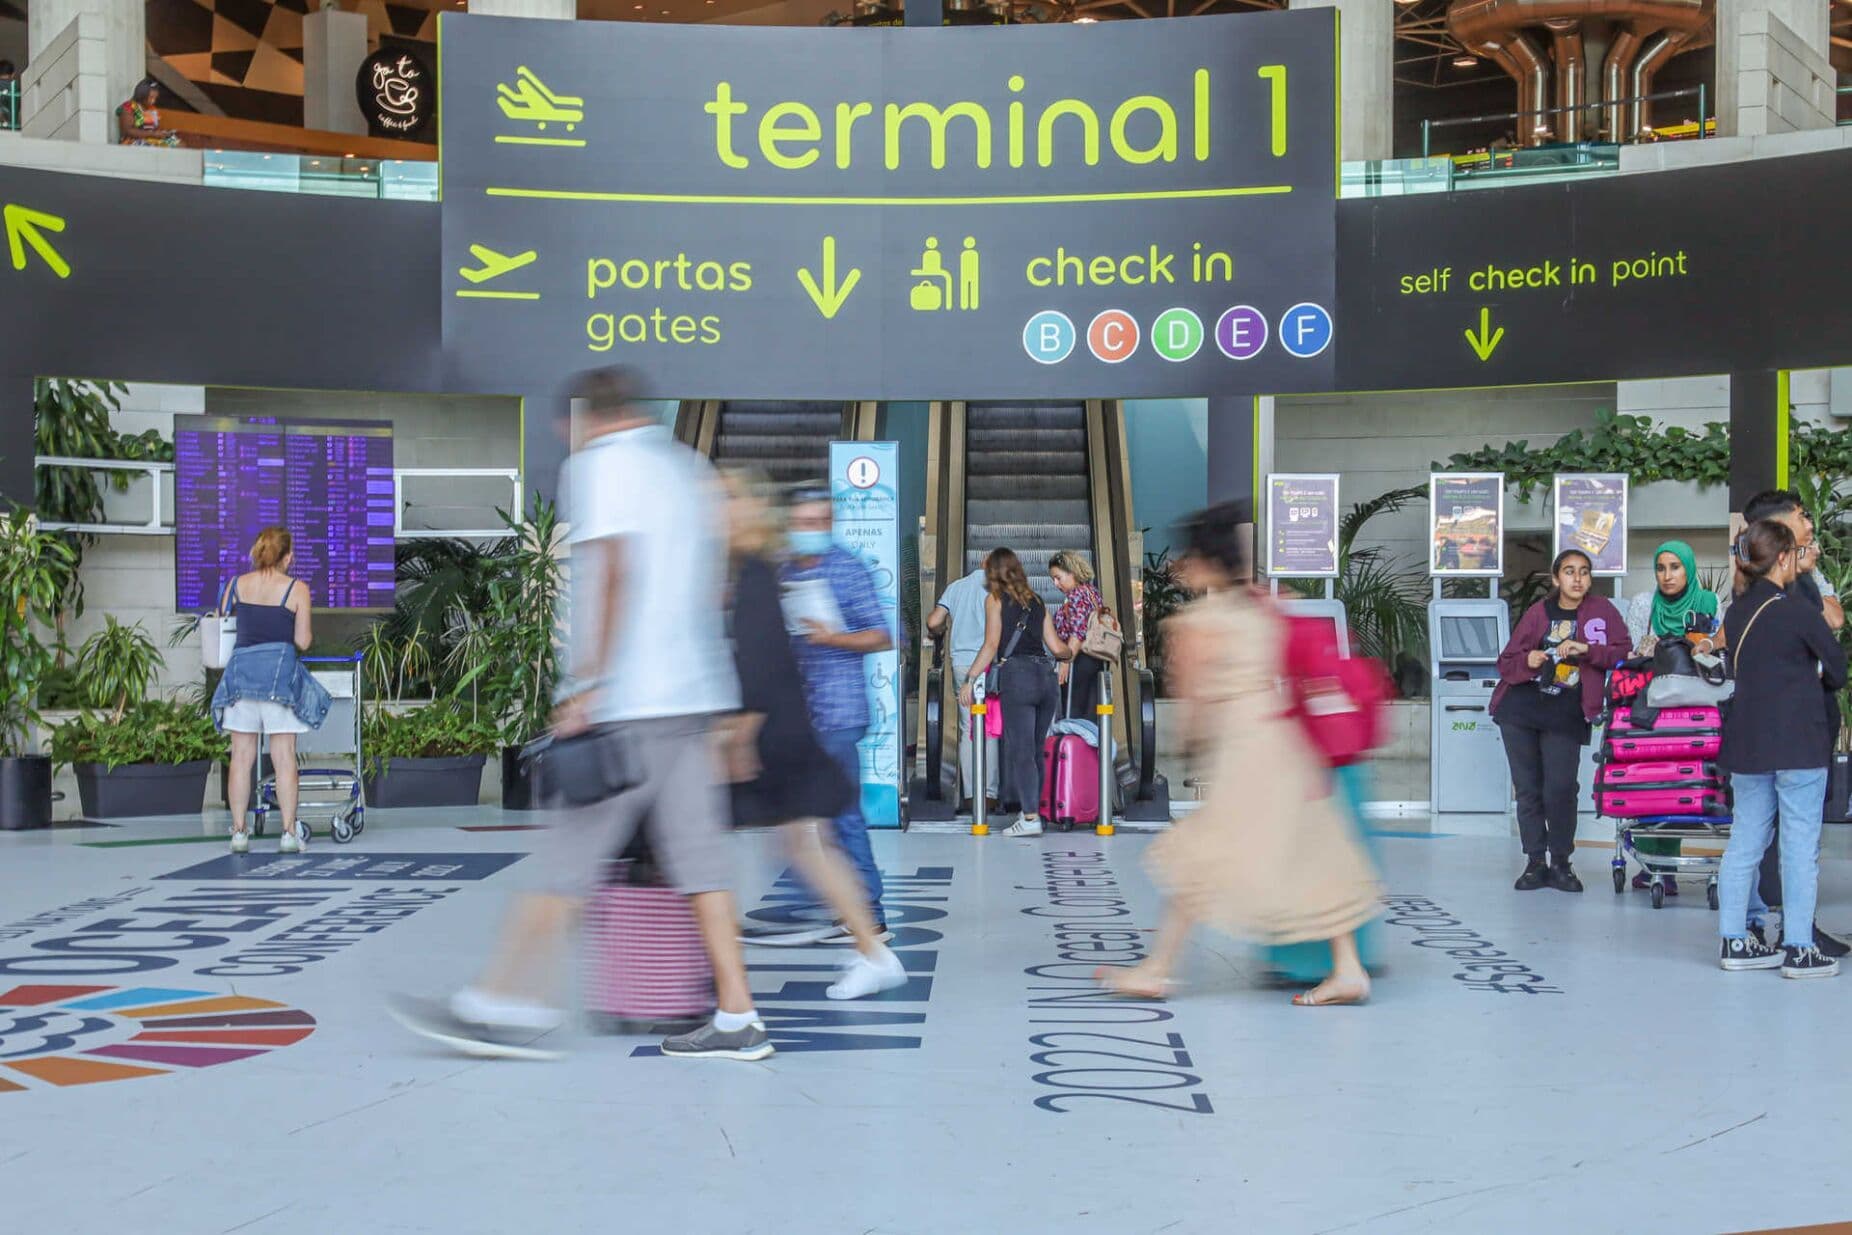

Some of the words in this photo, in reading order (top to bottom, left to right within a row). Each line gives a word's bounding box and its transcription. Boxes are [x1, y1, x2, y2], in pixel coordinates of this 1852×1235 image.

[373, 62, 395, 90] go
[396, 55, 421, 79] to
[704, 67, 1211, 170] terminal
[1256, 63, 1289, 158] 1
[586, 252, 753, 297] portas
[1026, 246, 1176, 287] check
[1192, 243, 1235, 283] in
[1399, 267, 1452, 296] self
[1467, 260, 1562, 292] check
[1570, 257, 1597, 285] in
[1611, 250, 1688, 288] point
[586, 308, 722, 352] gates
[1035, 319, 1063, 354] B
[1101, 318, 1126, 352] C
[1167, 317, 1196, 352] D
[1230, 316, 1253, 349] E
[1297, 314, 1317, 346] F
[845, 527, 883, 537] APENAS
[1583, 617, 1607, 646] S
[1013, 851, 1131, 919] Conference
[0, 887, 353, 976] OCEAN
[193, 887, 464, 977] CONFERENCE
[1023, 922, 1151, 982] Ocean
[1378, 894, 1566, 995] #SaveOurOcean
[1025, 986, 1175, 1024] UN
[1027, 1031, 1215, 1115] 2022
